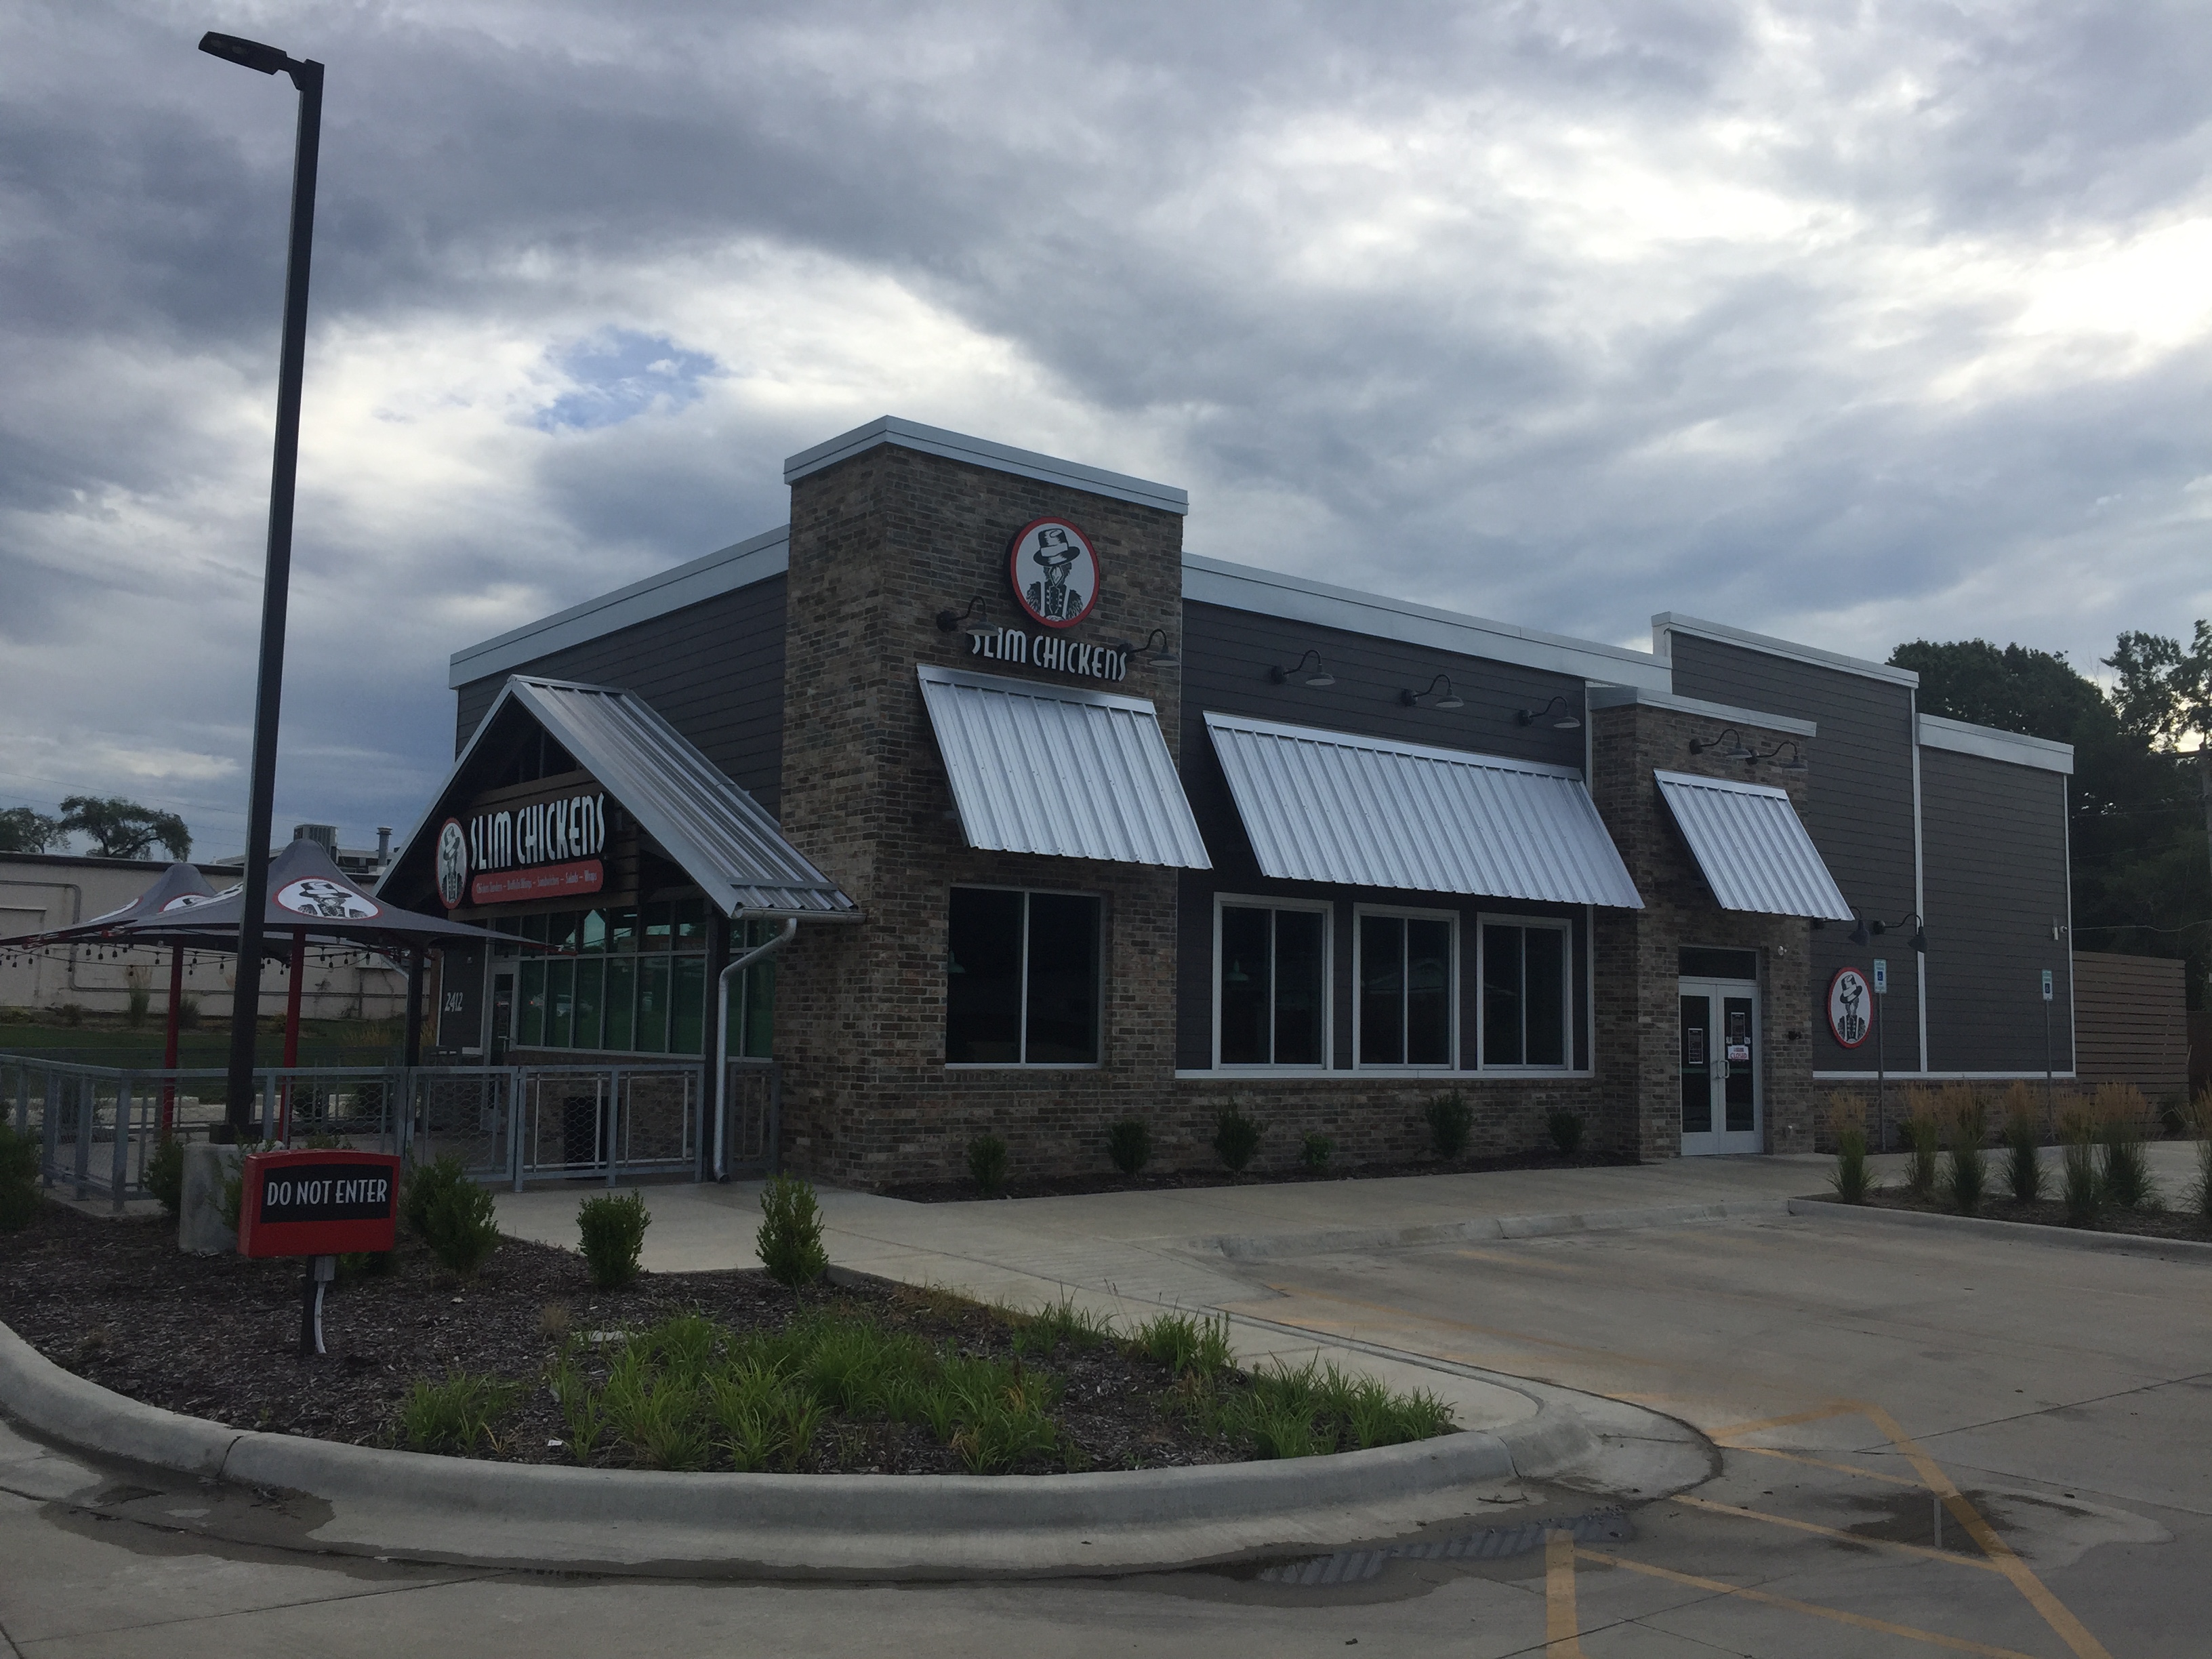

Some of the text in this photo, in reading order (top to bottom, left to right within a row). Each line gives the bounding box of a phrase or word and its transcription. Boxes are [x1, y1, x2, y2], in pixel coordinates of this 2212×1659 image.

[1033, 635, 1128, 682] CHICKENS
[470, 792, 605, 871] SLIM CHICKENS
[444, 991, 464, 1012] 2412
[267, 1179, 388, 1206] DO NOT ENTER
